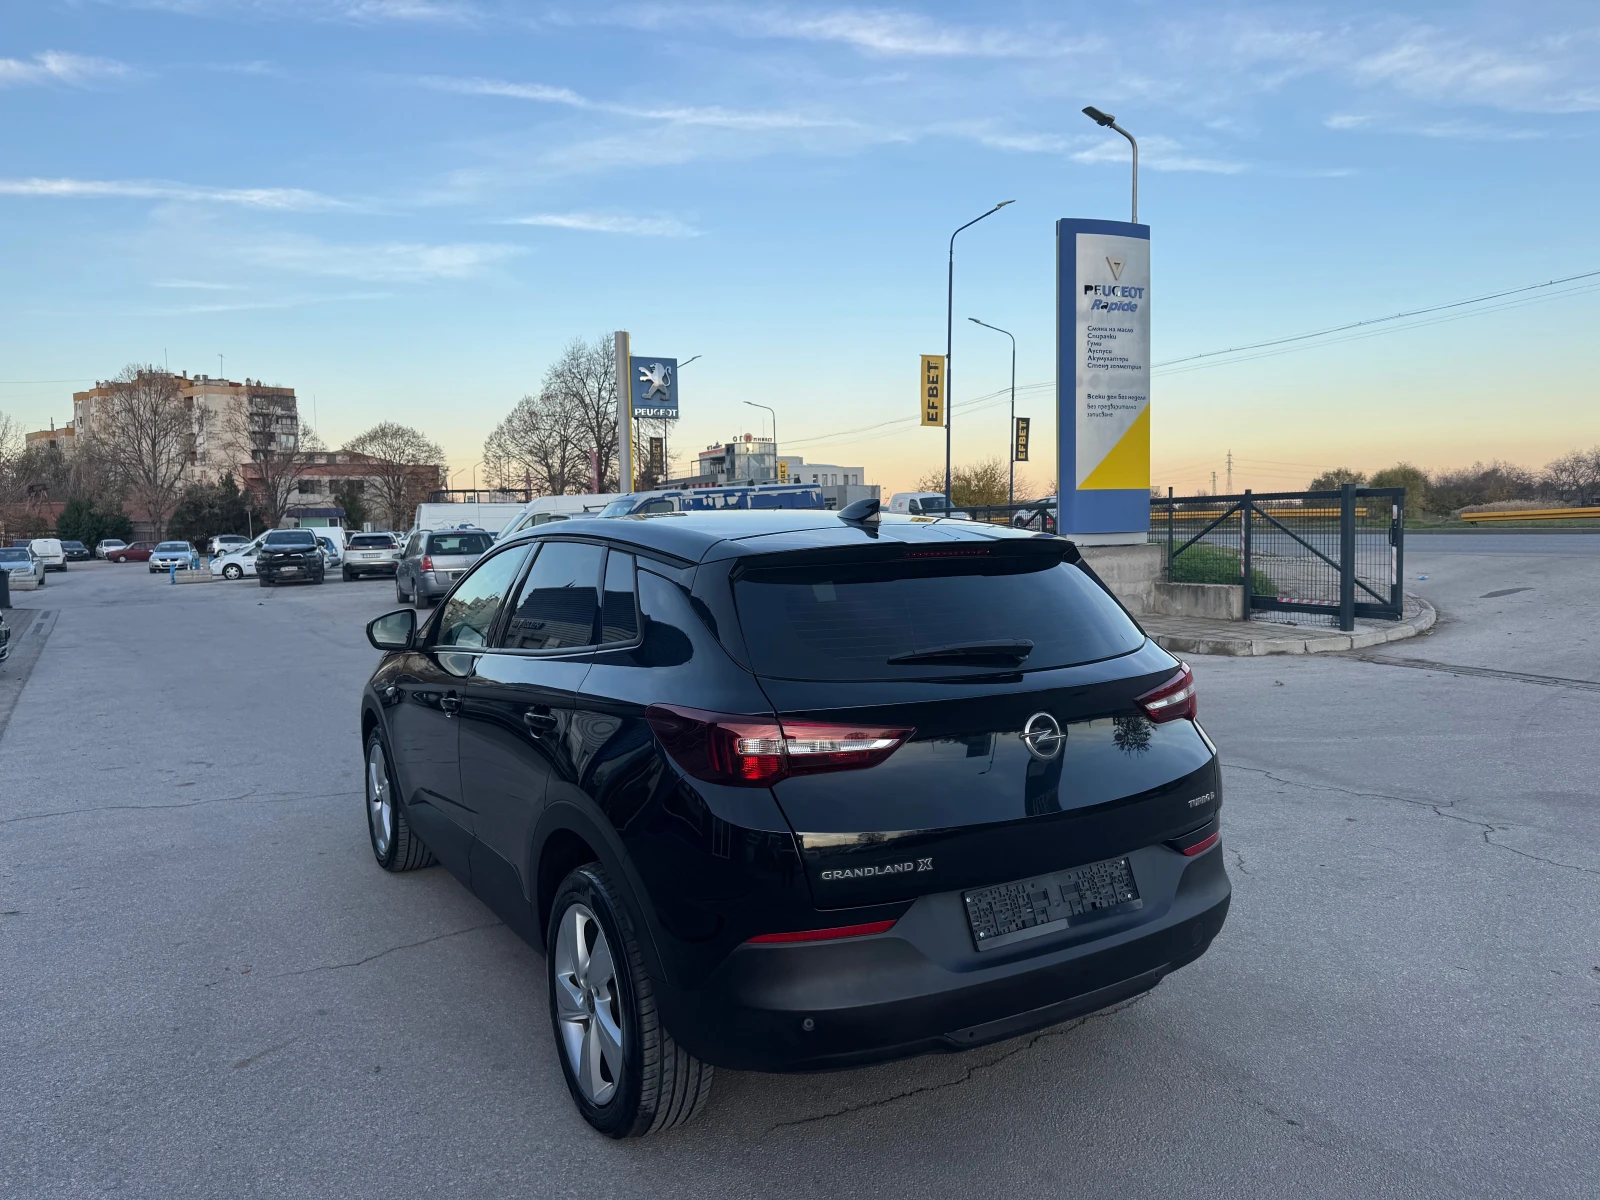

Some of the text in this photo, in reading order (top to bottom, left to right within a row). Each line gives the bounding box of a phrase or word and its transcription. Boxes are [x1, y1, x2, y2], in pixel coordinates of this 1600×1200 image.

[1084, 284, 1144, 299] PEUGEOT
[1091, 299, 1138, 313] Rapide
[1087, 332, 1117, 340] Спирачки
[926, 359, 939, 422] EFBET
[634, 408, 678, 417] PEUGEOT
[1017, 419, 1028, 460] EFBET
[821, 857, 933, 880] GRANDLAND X
